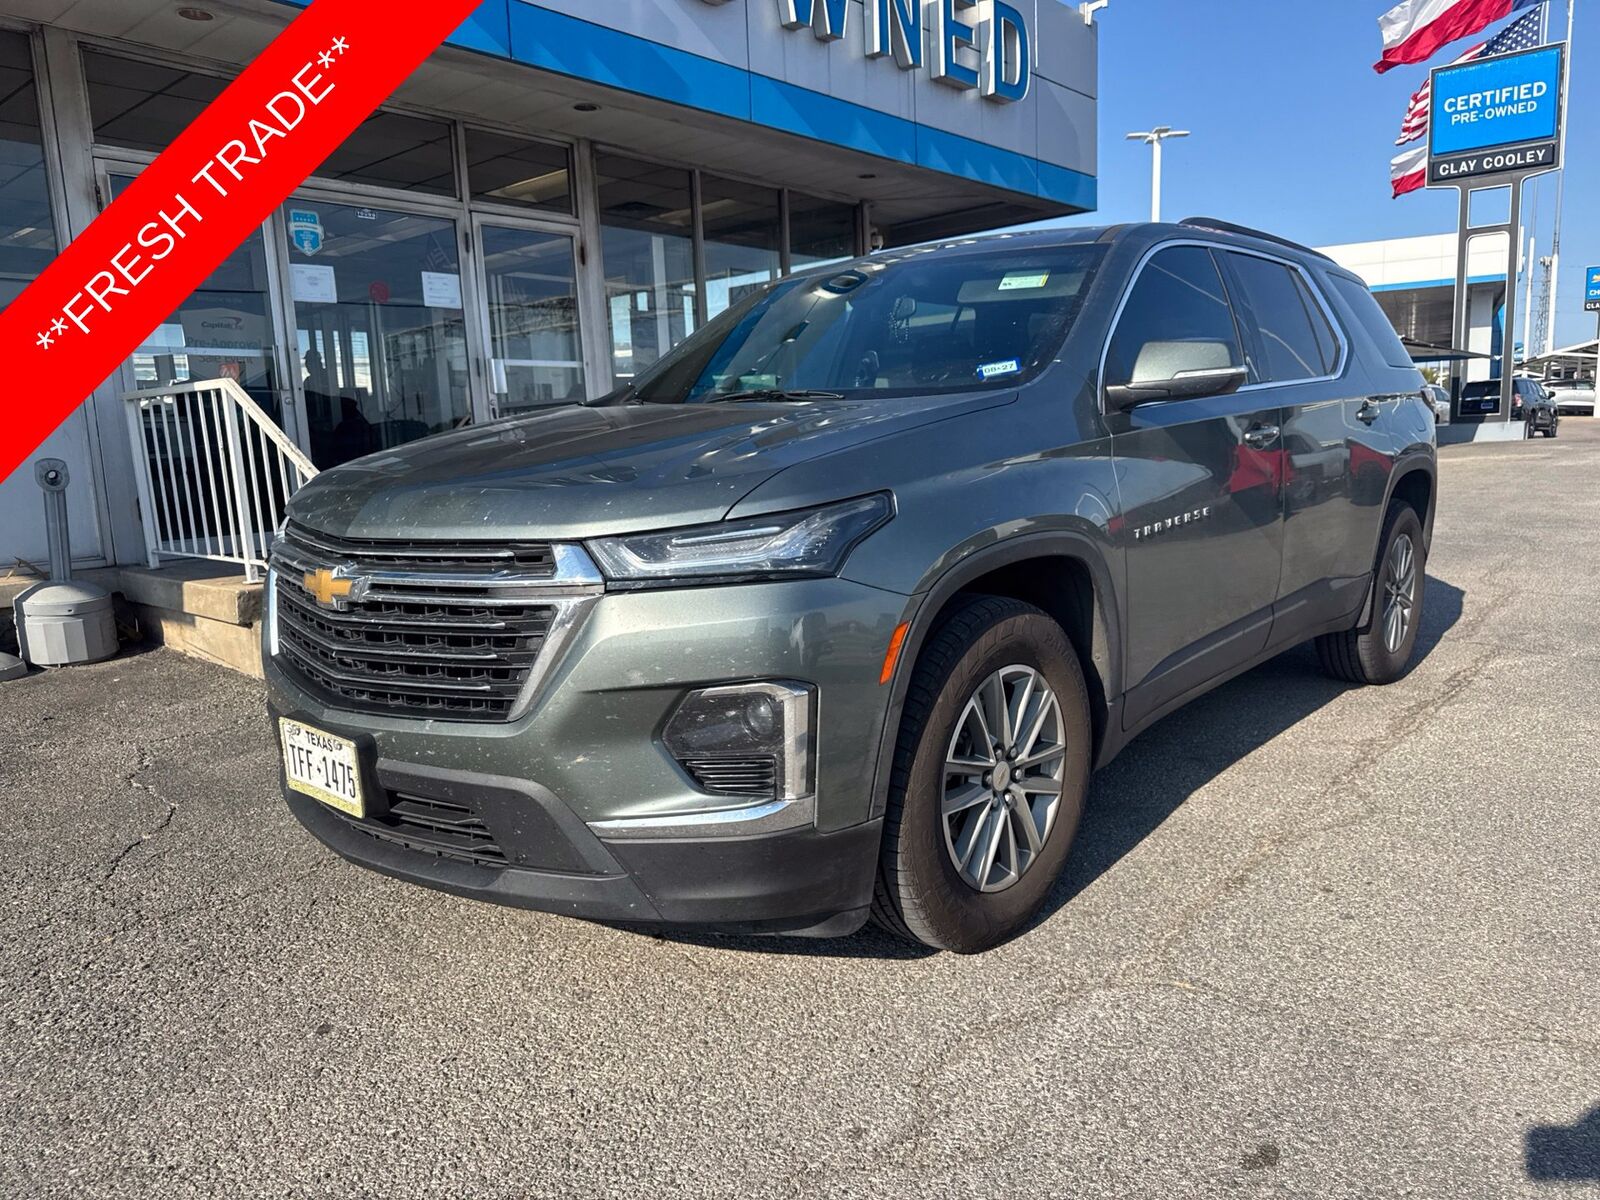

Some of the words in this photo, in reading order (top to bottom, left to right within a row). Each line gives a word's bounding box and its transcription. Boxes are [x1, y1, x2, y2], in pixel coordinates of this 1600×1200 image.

[1443, 81, 1547, 113] CERTIFIED
[1451, 100, 1537, 126] PRE-OWNED
[1439, 159, 1477, 176] CLAY
[1482, 149, 1546, 169] COOLEY
[1133, 506, 1211, 540] TRAVERSE
[305, 730, 334, 752] TEXAS
